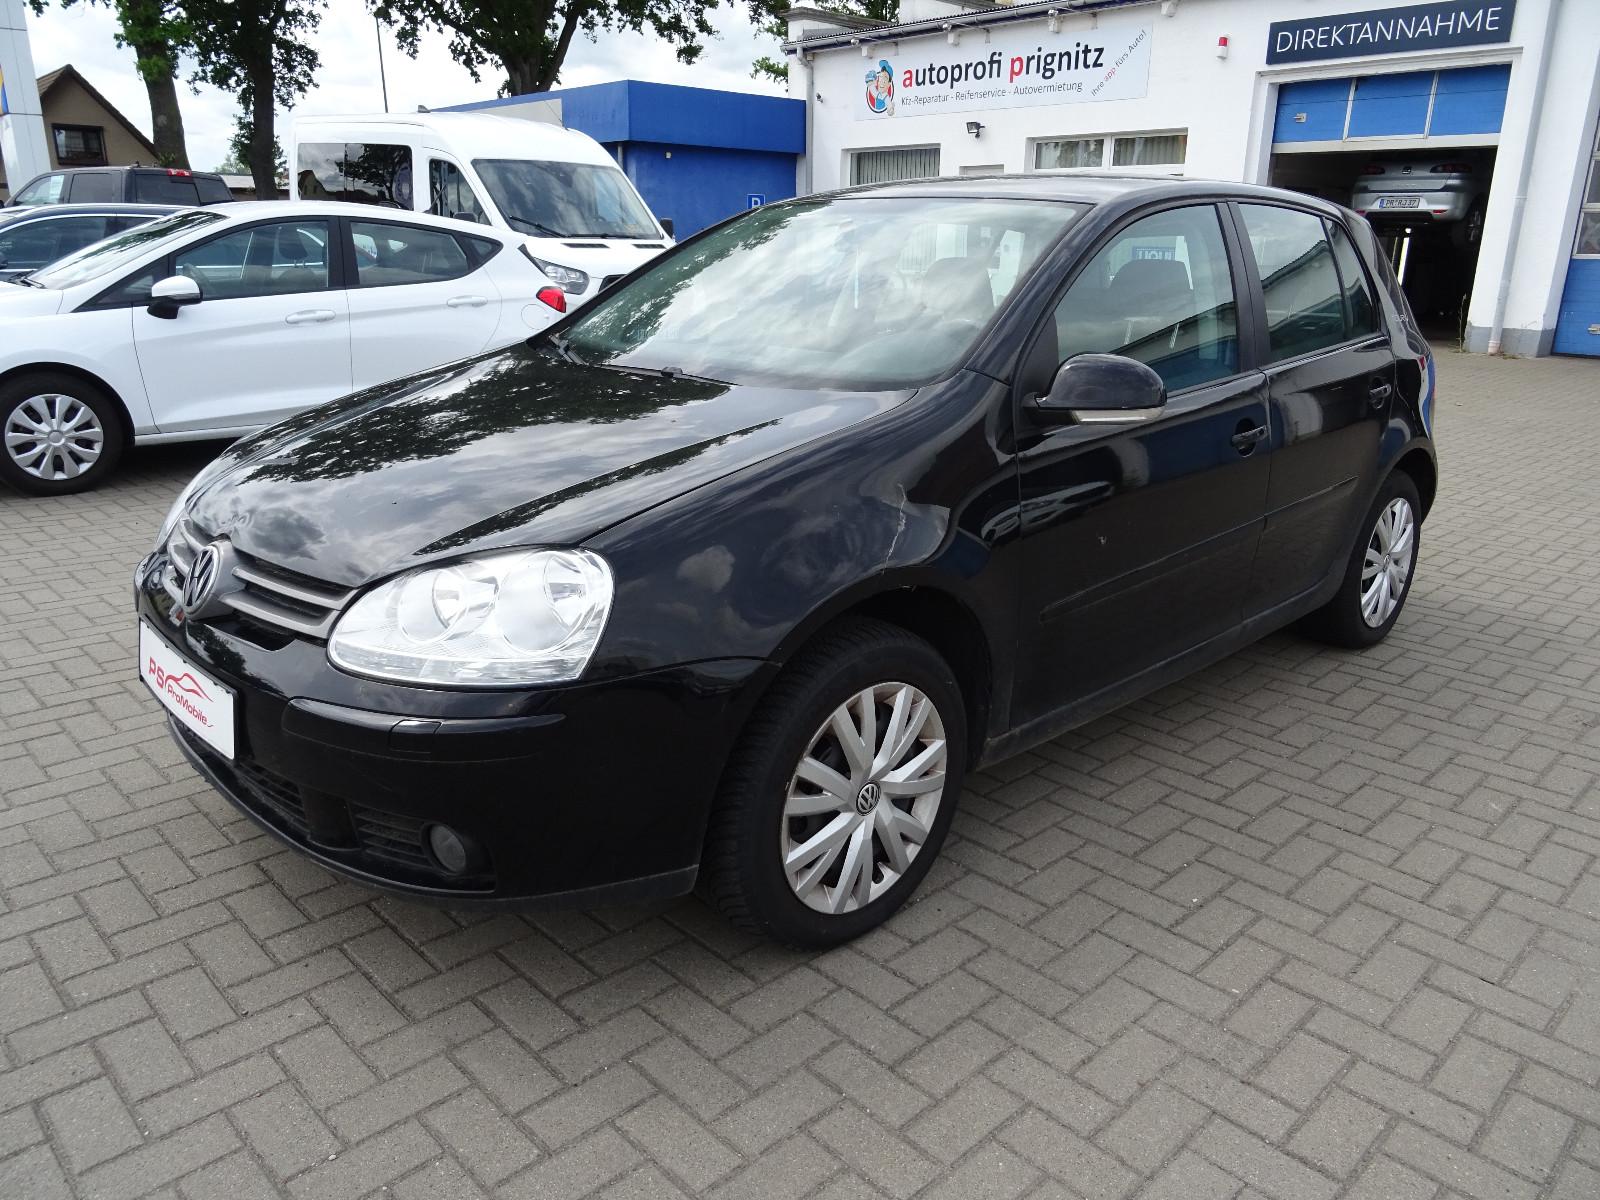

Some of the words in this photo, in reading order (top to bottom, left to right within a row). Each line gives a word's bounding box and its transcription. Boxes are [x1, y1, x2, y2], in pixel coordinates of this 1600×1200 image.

[1276, 7, 1502, 53] DIREKTANNAHME
[902, 51, 1003, 89] autoprofi
[1009, 41, 1105, 83] prignitz
[1091, 81, 1104, 97] Ihre
[1104, 67, 1116, 81] app
[901, 95, 949, 106] Kfz-Reparatur
[955, 88, 1006, 101] Reifenservice
[1013, 81, 1083, 95] Autovermietung
[148, 656, 165, 689] PS
[167, 684, 208, 726] ProMobile
